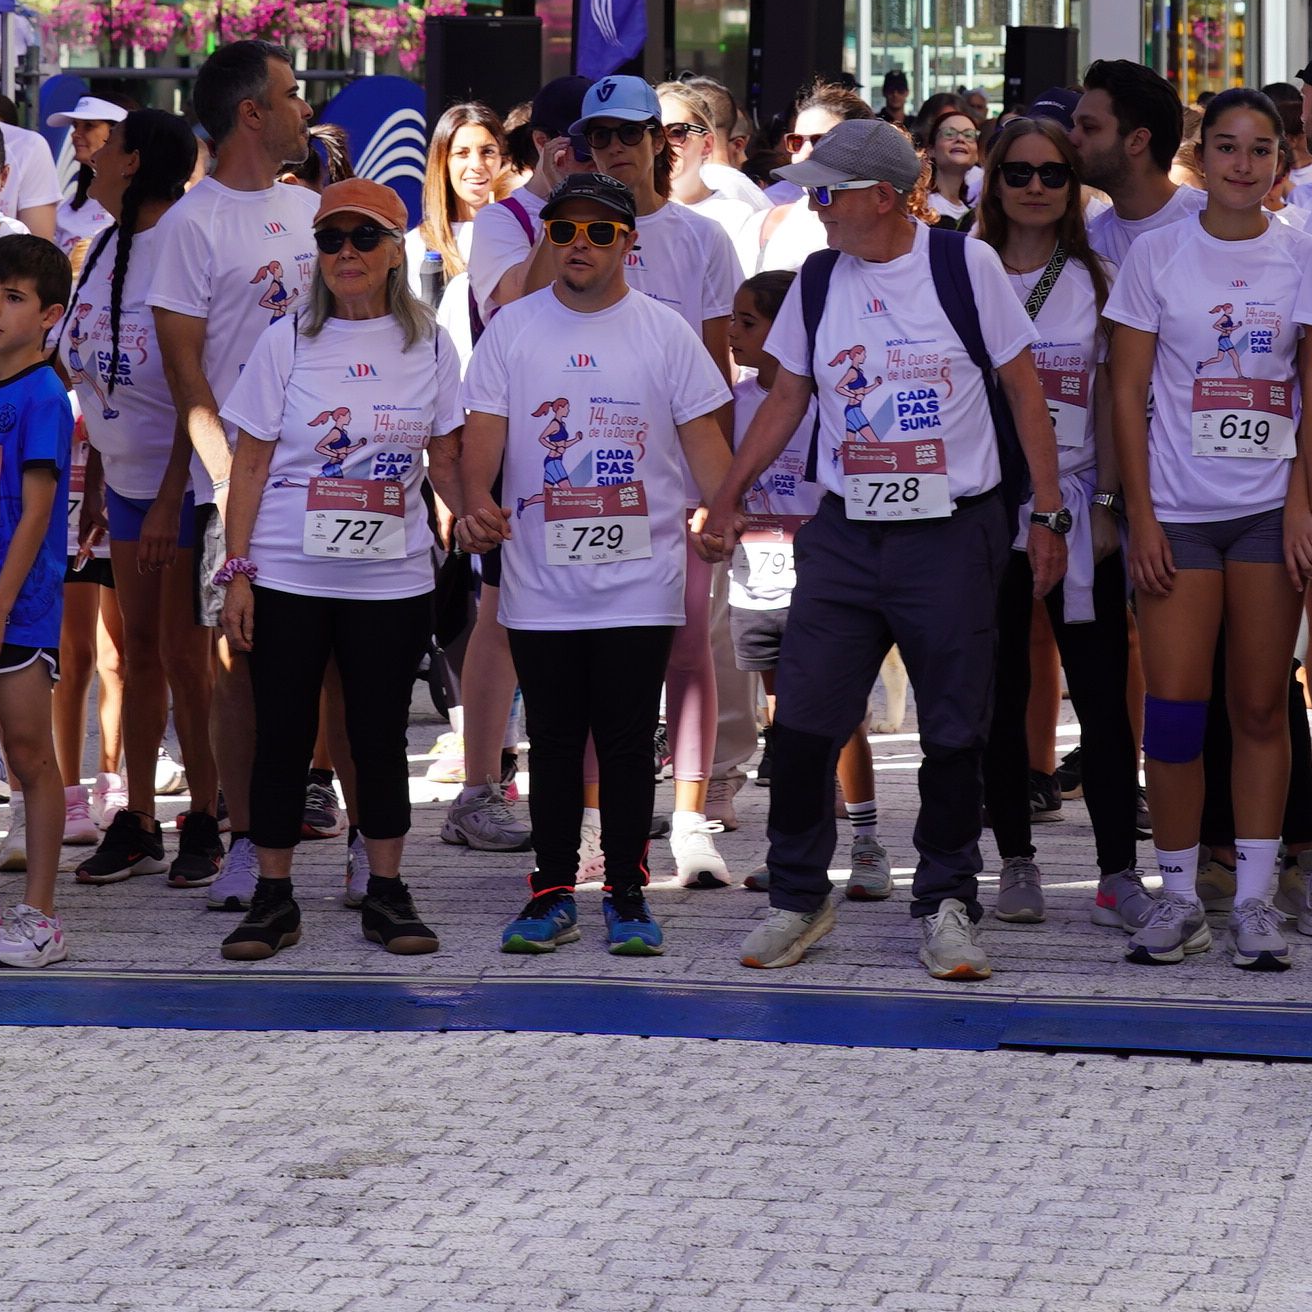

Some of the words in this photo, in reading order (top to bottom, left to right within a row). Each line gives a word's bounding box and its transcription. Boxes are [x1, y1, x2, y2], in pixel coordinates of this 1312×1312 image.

[97, 351, 130, 363] CAA
[1053, 355, 1081, 367] Cursa
[345, 362, 378, 378] ADA
[101, 374, 135, 385] SMA
[896, 388, 938, 402] CADA
[898, 400, 939, 417] PAS
[900, 414, 942, 431] SUMA
[1219, 414, 1270, 445] 619
[376, 452, 412, 463] CADA
[596, 449, 634, 460] CADA
[915, 450, 937, 458] PAS
[374, 464, 411, 476] PAS
[596, 461, 635, 474] PAS
[774, 480, 795, 488] PAS
[619, 492, 639, 500] PAS
[867, 477, 920, 507] 728
[331, 519, 384, 545] 727
[571, 524, 624, 552] 729
